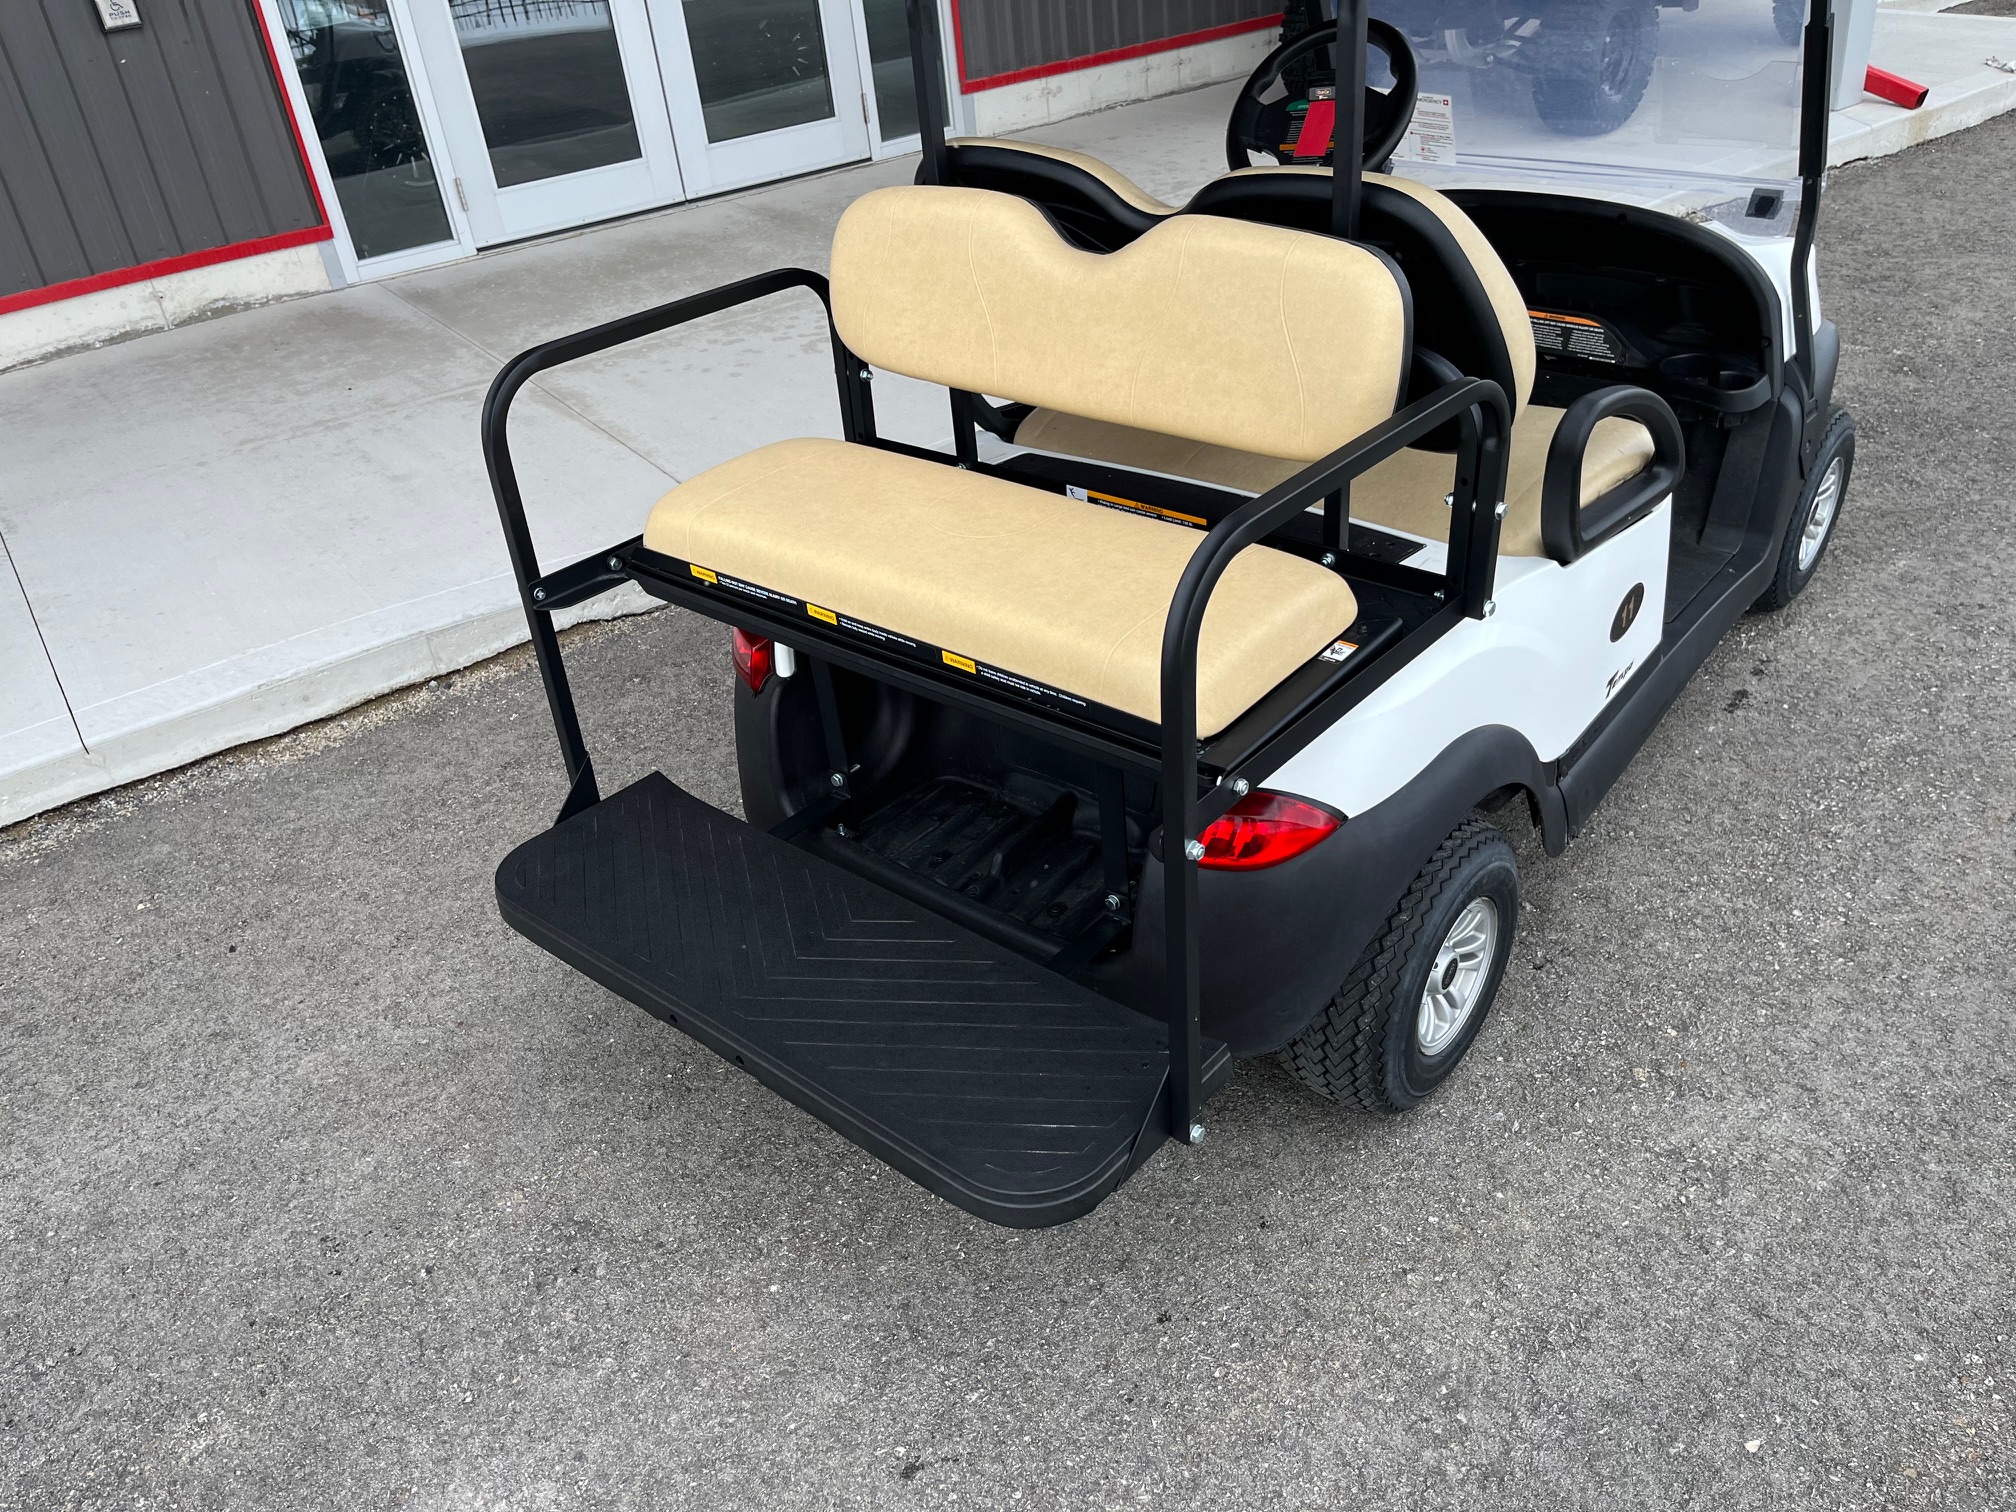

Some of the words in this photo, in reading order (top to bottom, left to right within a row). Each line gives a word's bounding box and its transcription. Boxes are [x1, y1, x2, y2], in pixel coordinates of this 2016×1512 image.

[1140, 504, 1163, 514] WARNING
[696, 570, 715, 580] WARNING
[813, 609, 834, 620] WARNING
[1621, 595, 1635, 628] 11
[949, 656, 973, 669] WARNING
